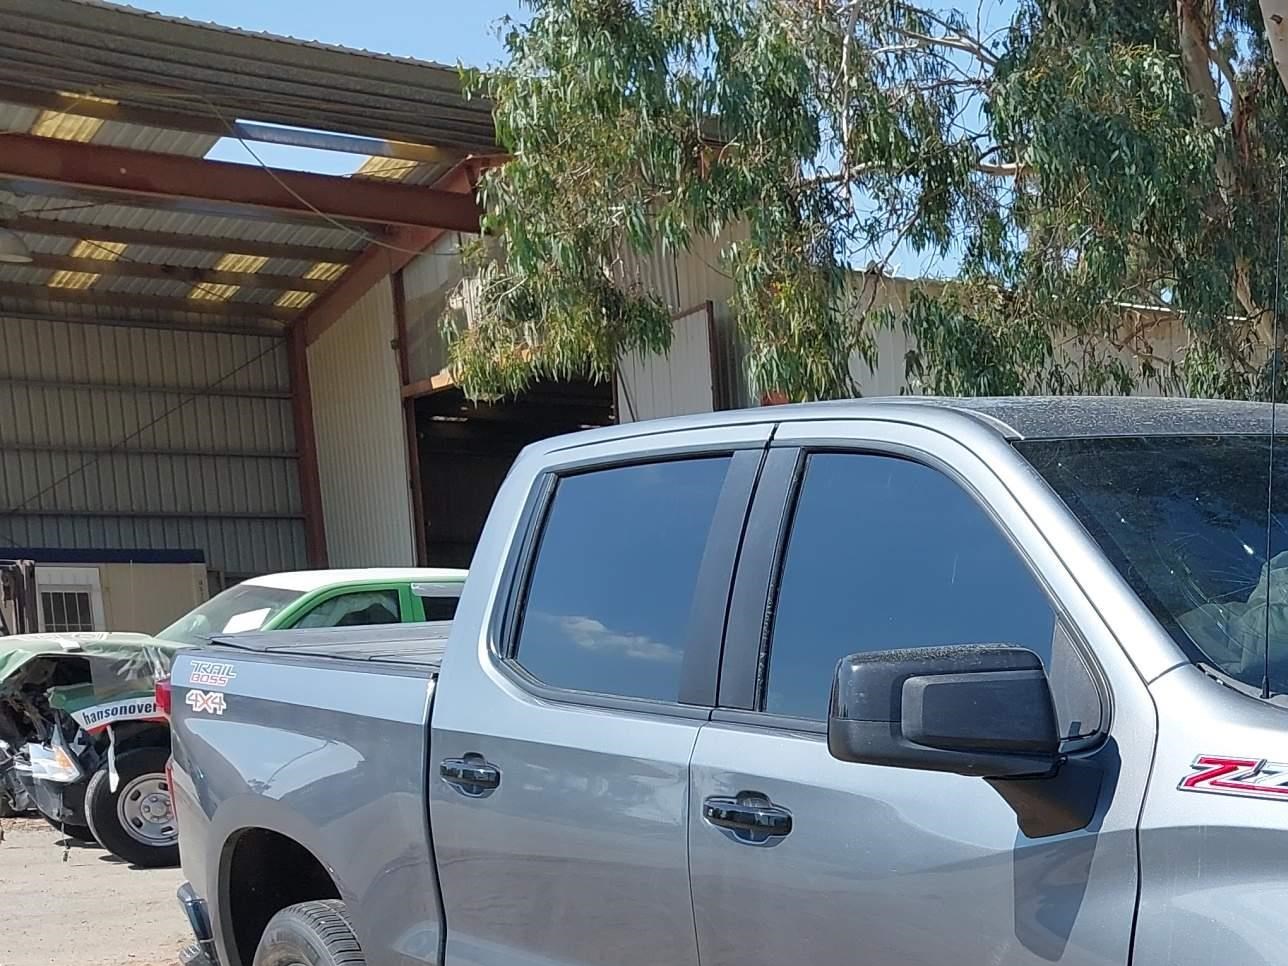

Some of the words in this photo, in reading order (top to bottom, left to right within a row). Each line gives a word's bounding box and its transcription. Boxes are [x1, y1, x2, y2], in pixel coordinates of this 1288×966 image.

[191, 660, 237, 679] TRAIL
[190, 673, 229, 687] BOSS
[186, 689, 228, 716] 4X4
